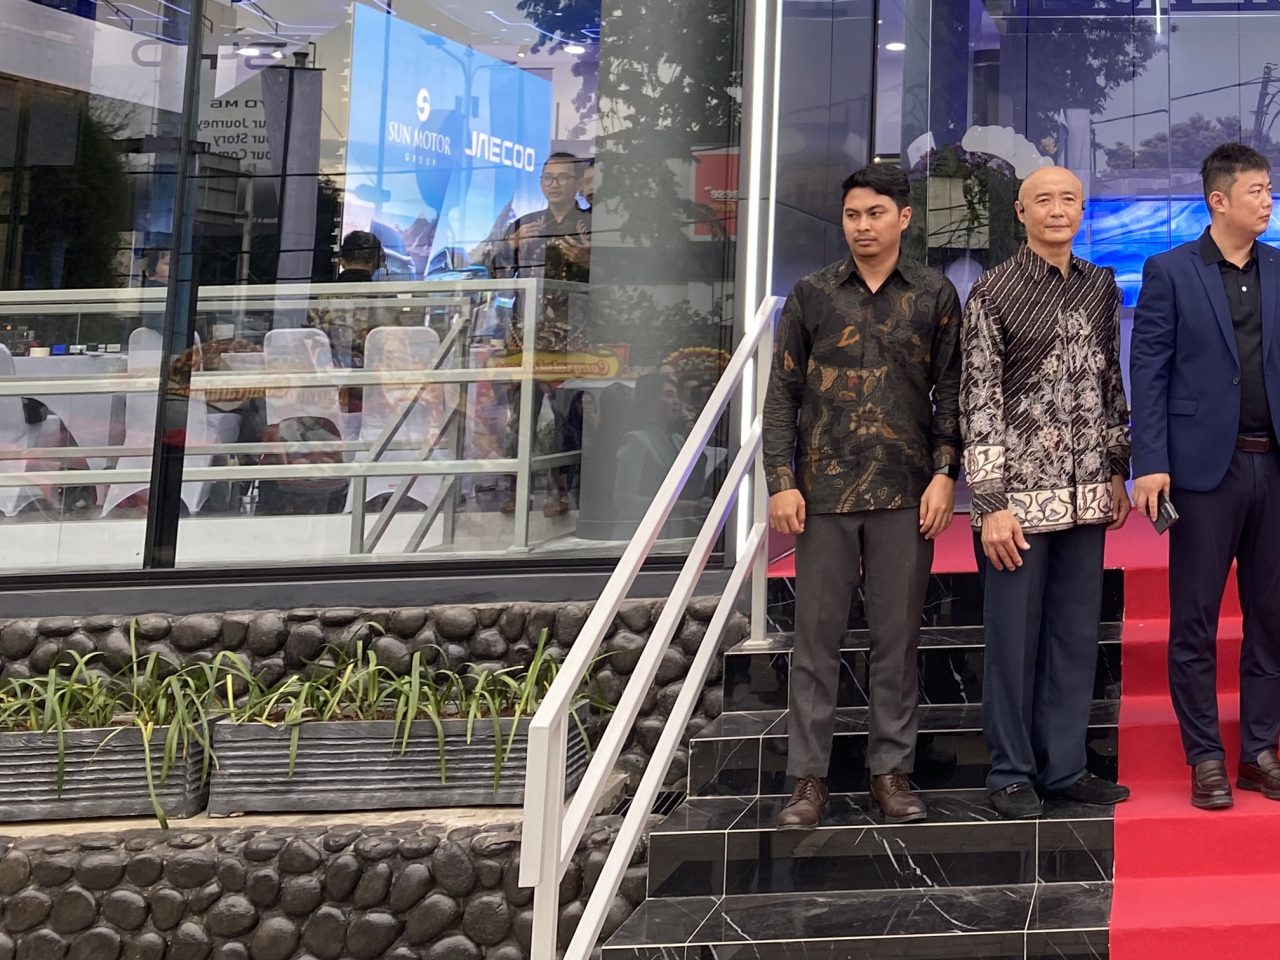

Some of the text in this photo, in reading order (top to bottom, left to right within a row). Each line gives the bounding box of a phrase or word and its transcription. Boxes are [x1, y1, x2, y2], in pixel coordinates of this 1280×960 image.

[388, 121, 452, 156] SUN MOTOR
[464, 130, 535, 172] JAECOO
